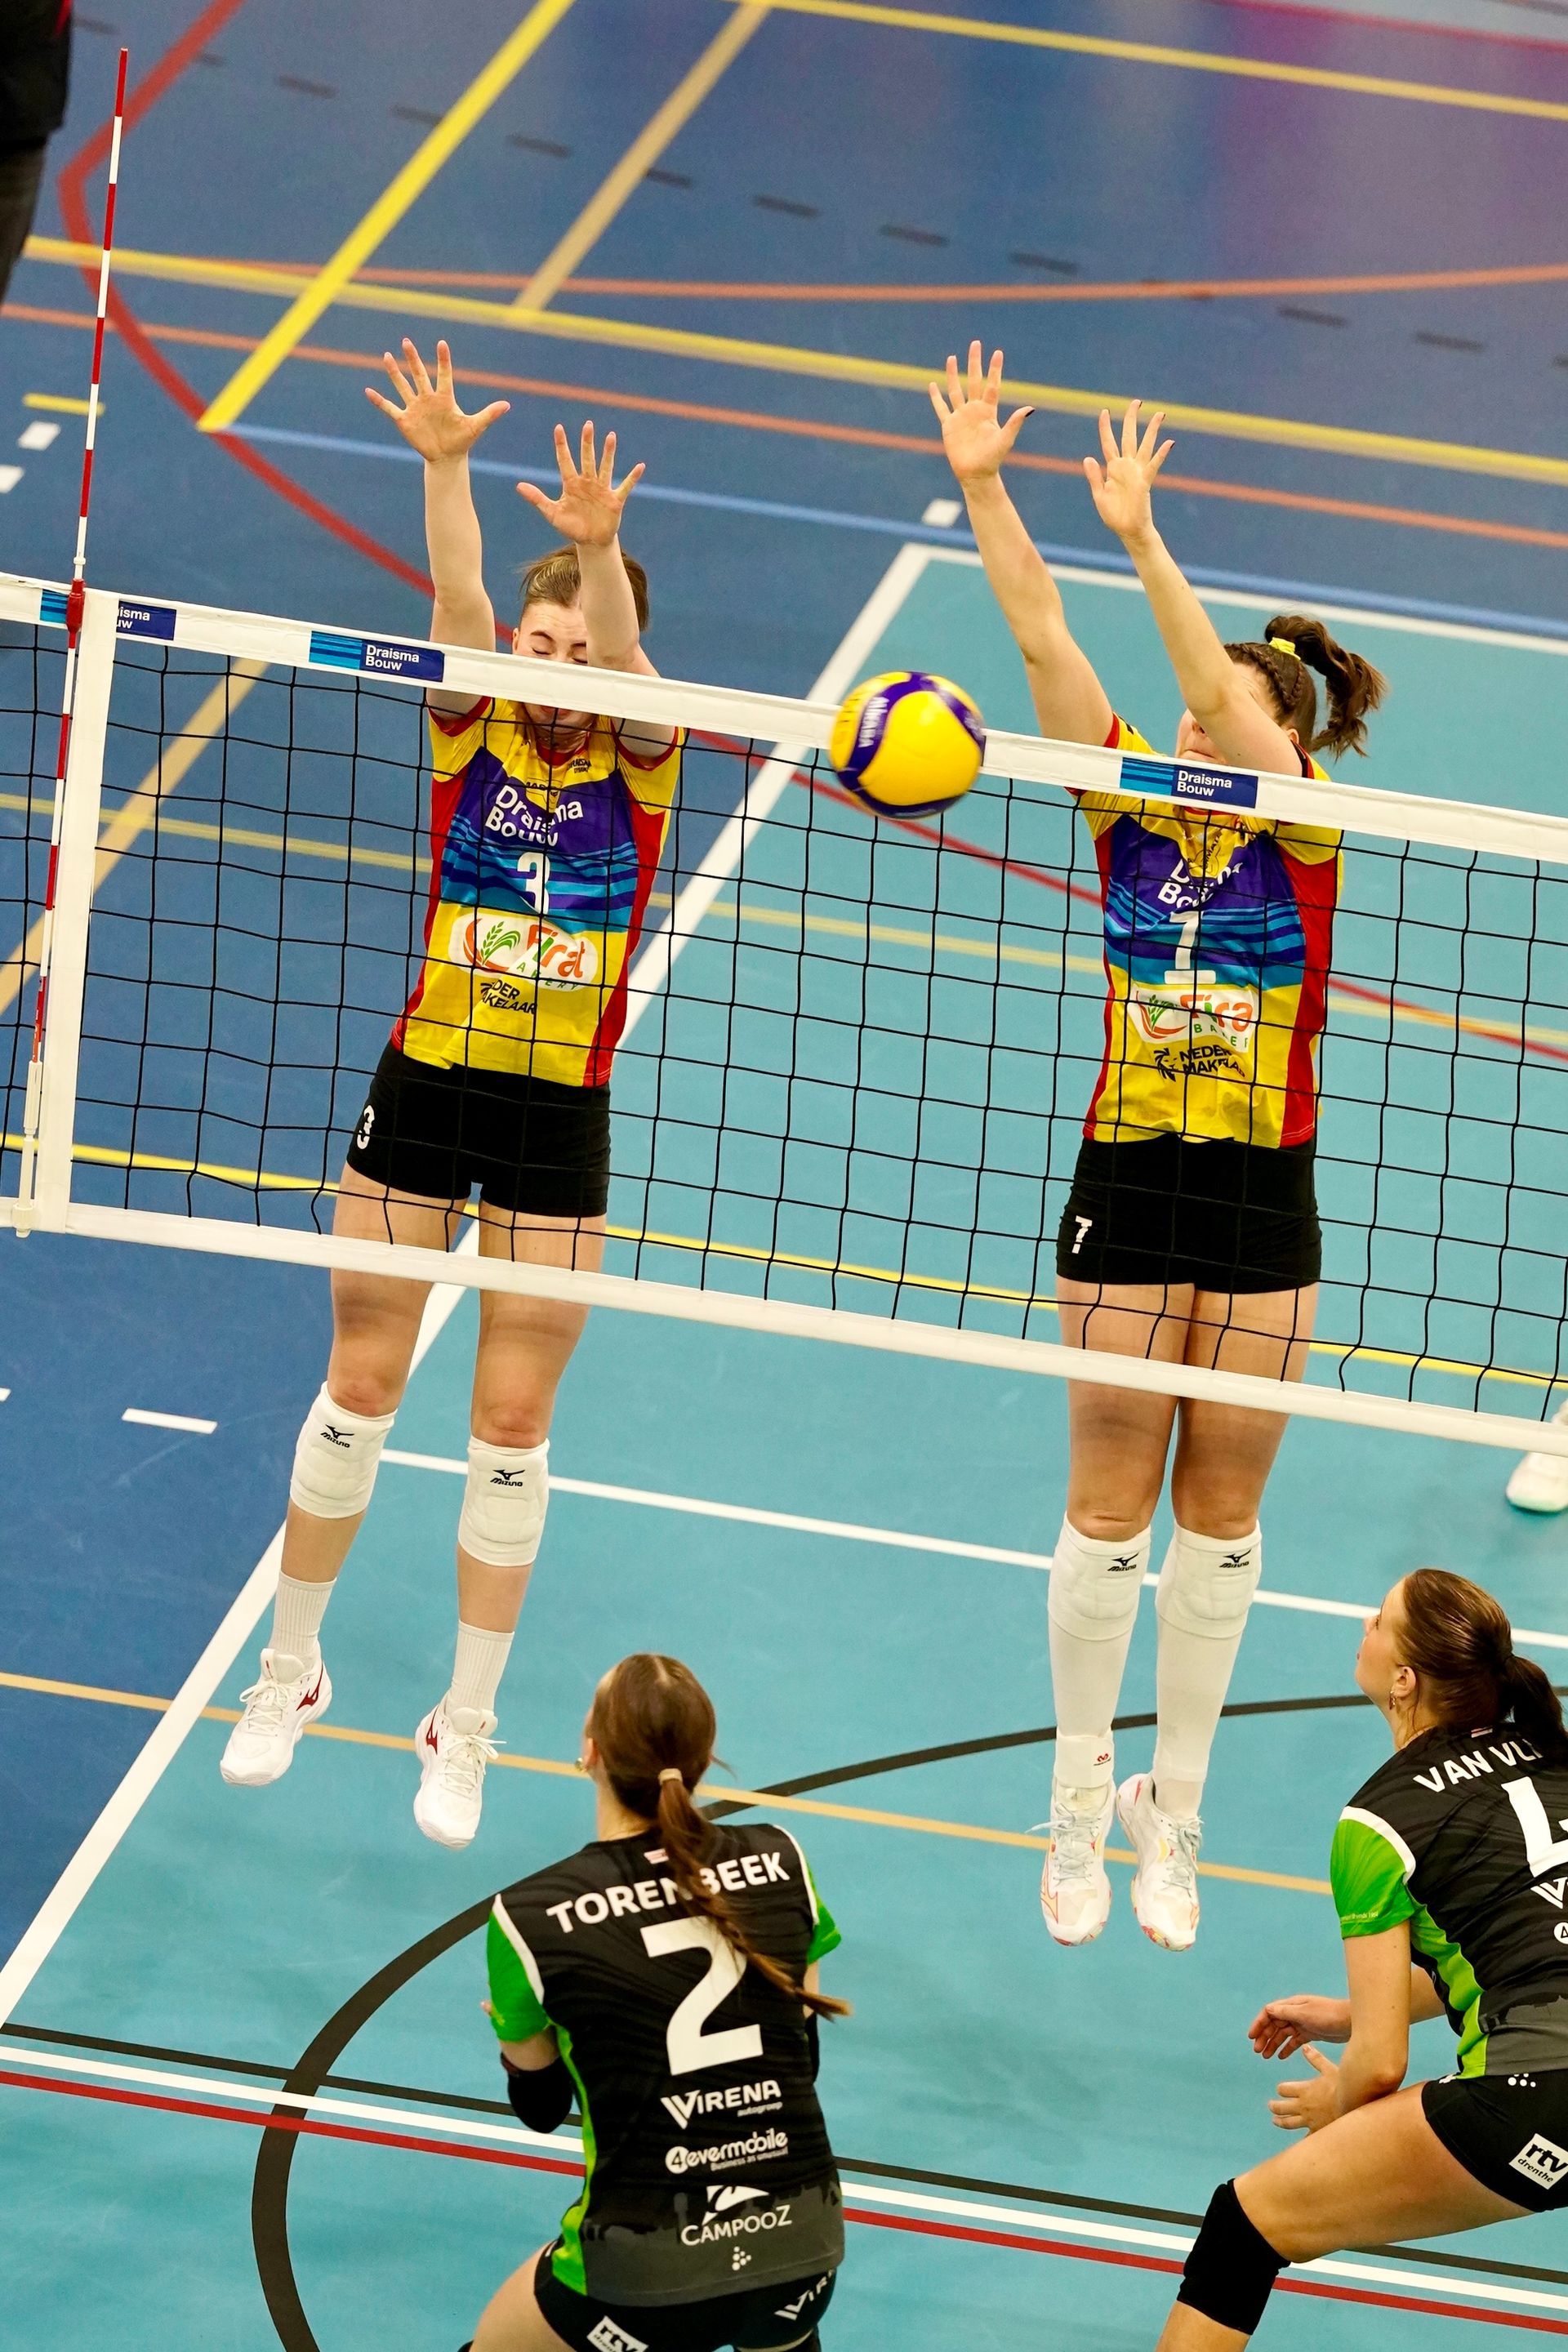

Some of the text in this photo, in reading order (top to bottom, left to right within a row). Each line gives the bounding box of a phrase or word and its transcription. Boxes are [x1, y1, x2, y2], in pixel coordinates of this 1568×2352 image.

[118, 606, 150, 621] isma
[365, 655, 402, 670] Bouw
[366, 644, 420, 663] Draisma
[1177, 781, 1214, 797] Bouw
[1178, 769, 1232, 788] Draisma
[517, 852, 550, 915] 3
[356, 1104, 376, 1150] 3
[1071, 1214, 1093, 1254] 7
[1413, 1750, 1494, 1793] VAN
[546, 1851, 791, 1934] TORENBEEK
[639, 1914, 764, 2076] 2
[660, 2079, 782, 2130] VIRENA
[665, 2127, 789, 2175] 4evermobile
[1517, 2158, 1554, 2183] drenthe
[1526, 2143, 1568, 2173] rtv
